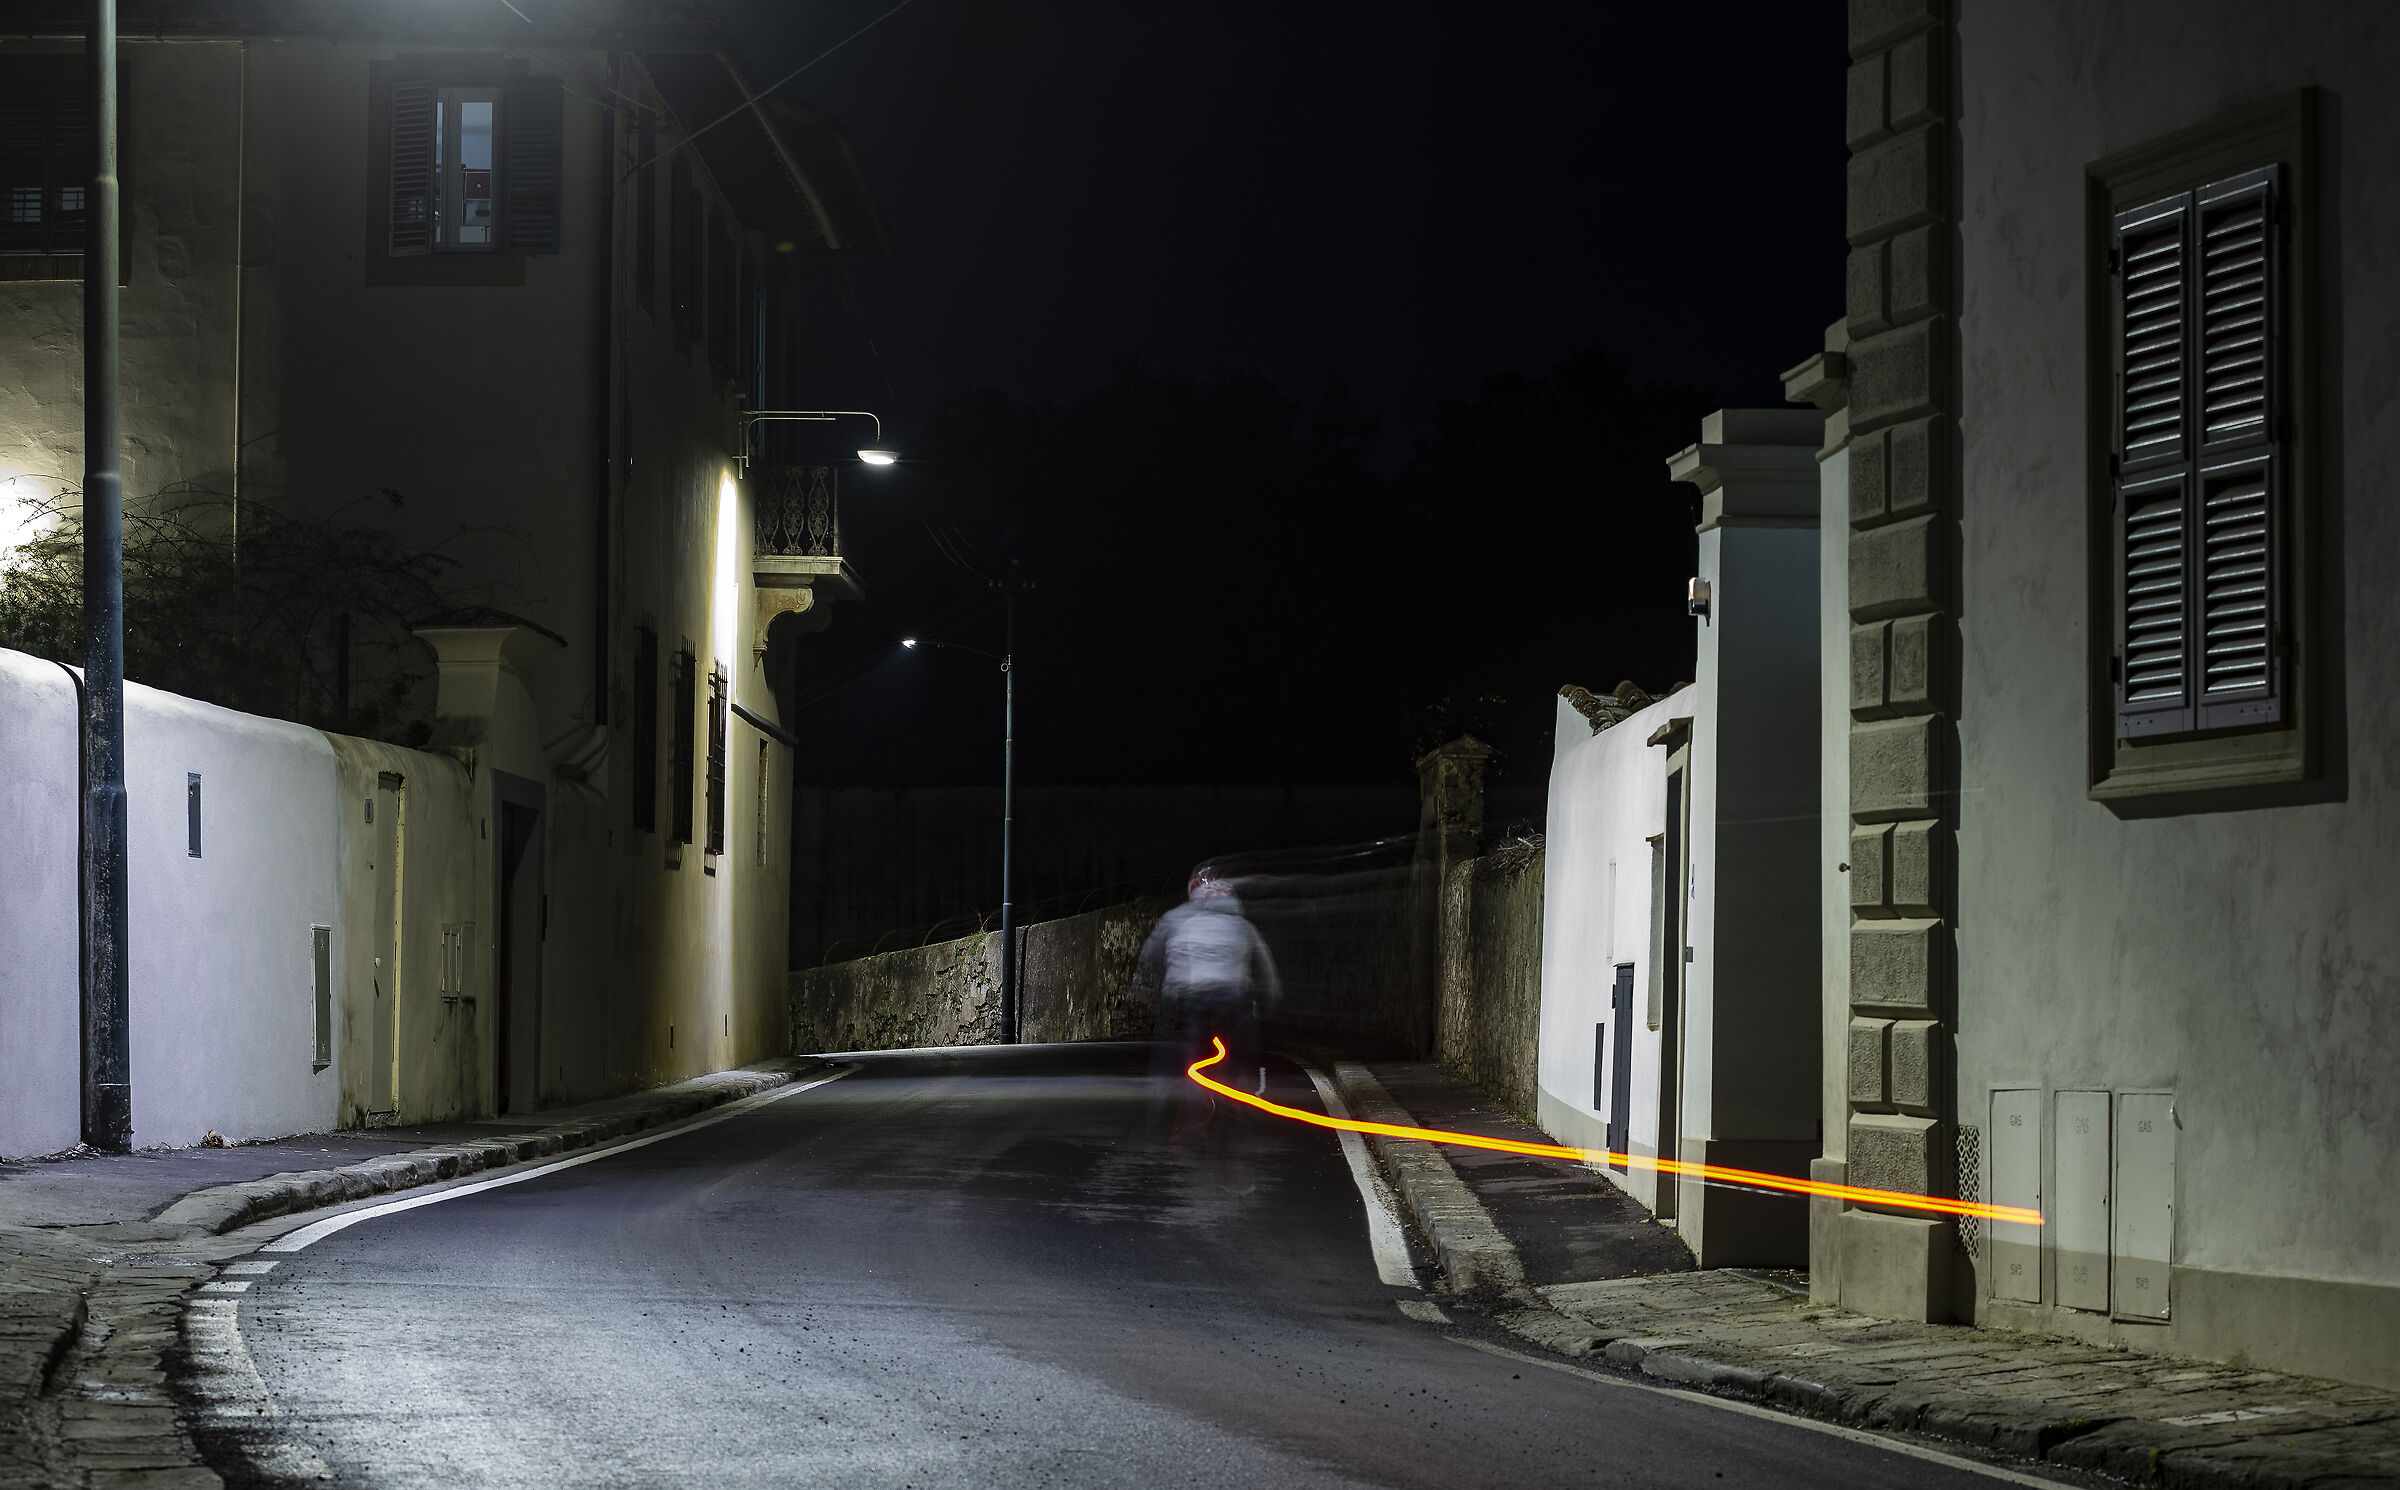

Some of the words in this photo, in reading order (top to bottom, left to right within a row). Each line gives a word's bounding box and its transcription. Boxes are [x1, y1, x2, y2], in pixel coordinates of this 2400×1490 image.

[2010, 1115, 2022, 1126] GAS
[2074, 1117, 2089, 1134] GAS
[2138, 1121, 2152, 1132] GAS
